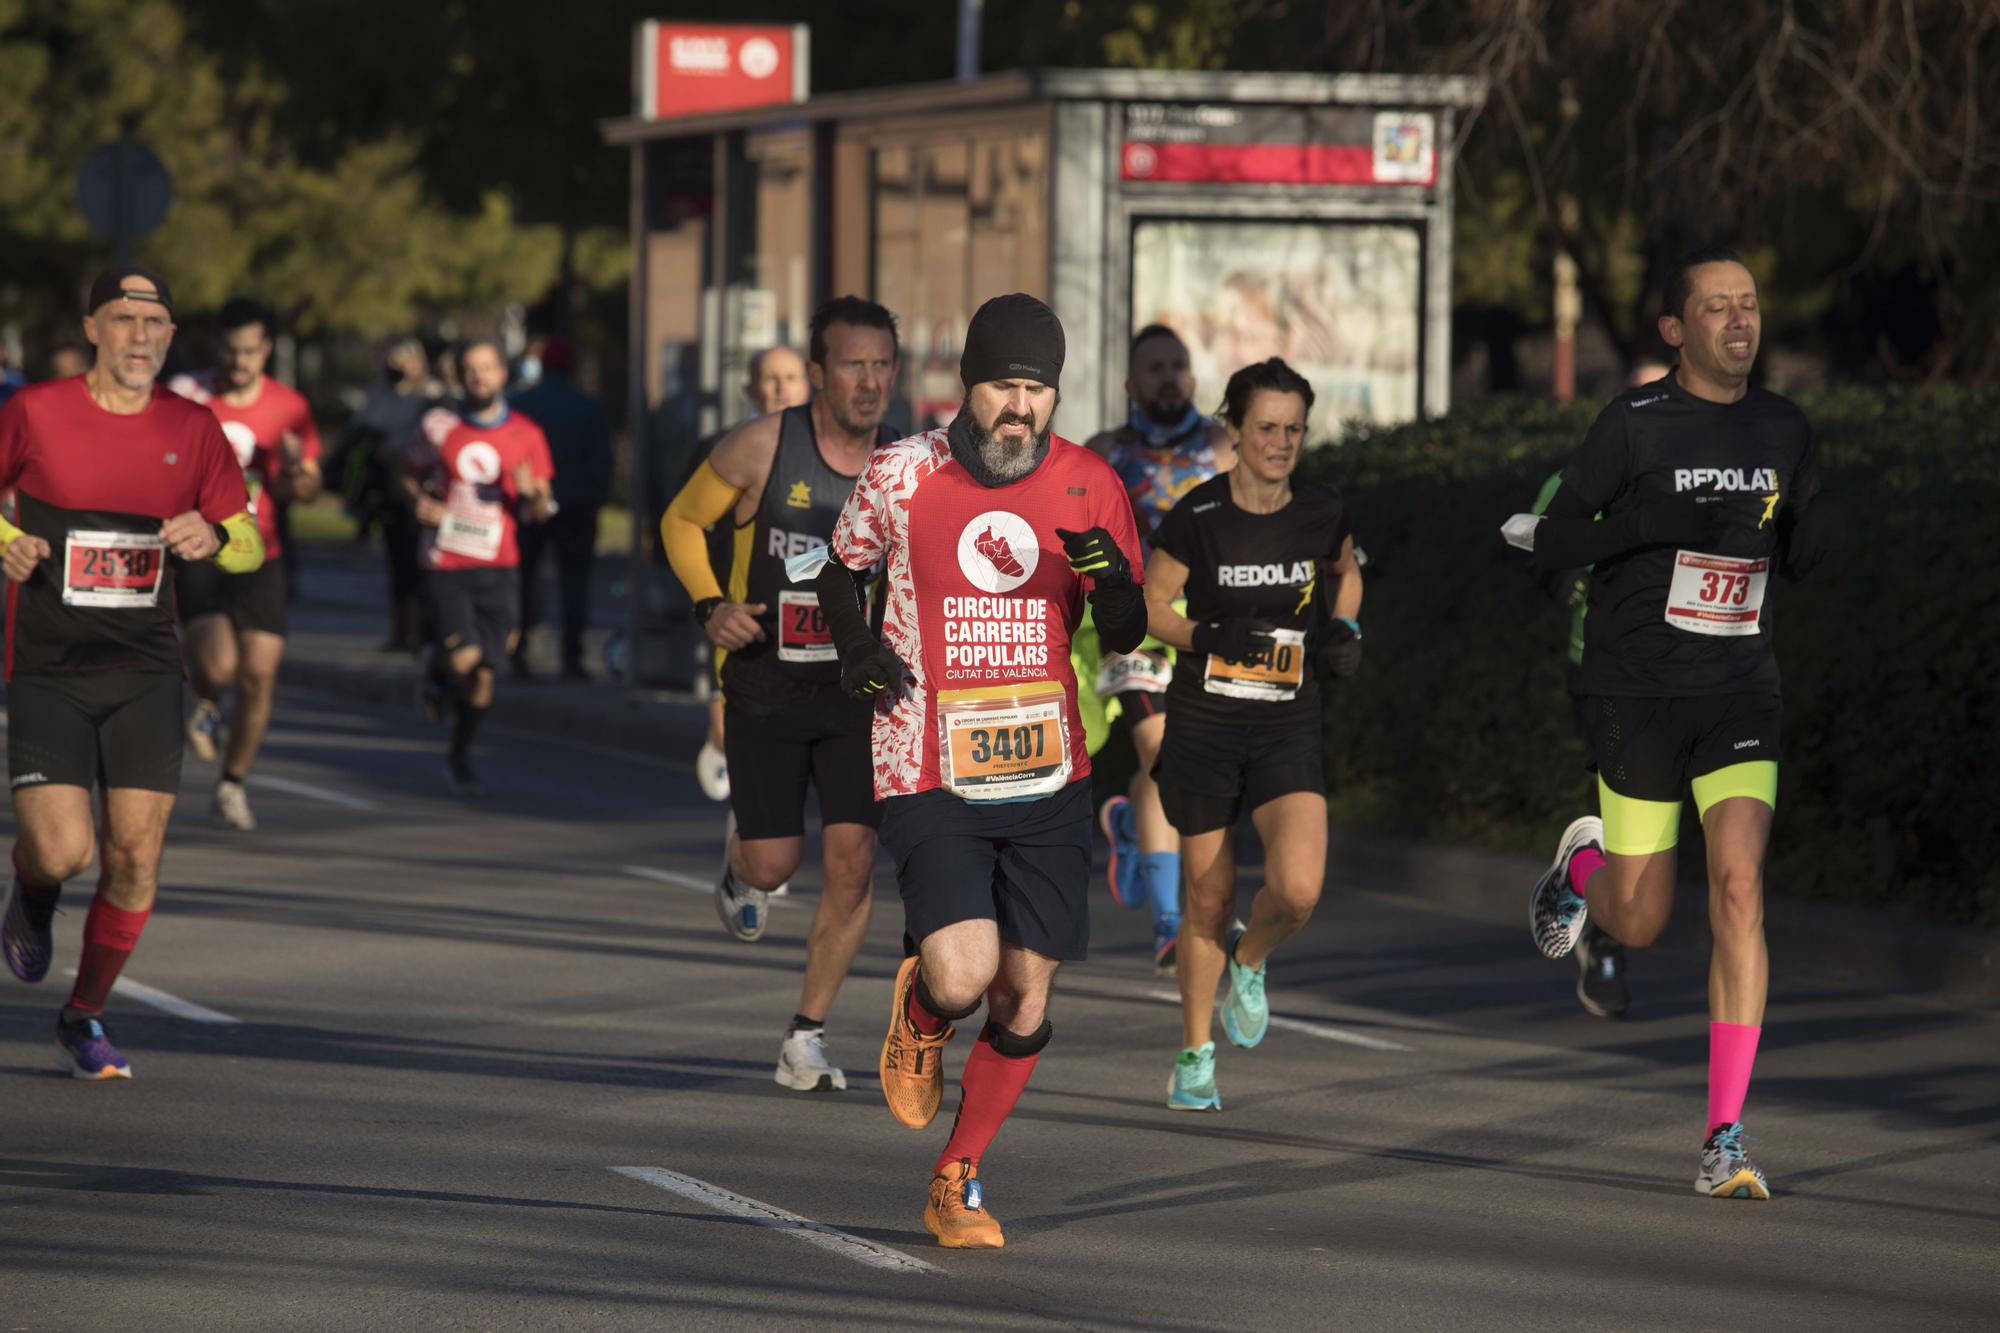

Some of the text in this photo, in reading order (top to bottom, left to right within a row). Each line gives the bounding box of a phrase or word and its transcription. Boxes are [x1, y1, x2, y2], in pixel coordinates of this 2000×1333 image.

[1674, 467, 1775, 492] REDOLAT
[1218, 560, 1312, 587] REDOLAT
[1699, 571, 1750, 606] 373
[943, 596, 1047, 620] CIRCUIT DE
[944, 621, 1047, 643] CARRERES
[945, 645, 1048, 667] POPULARS
[946, 666, 1048, 680] CIUTAT DE VALÈNCIA
[971, 723, 1044, 763] 3407
